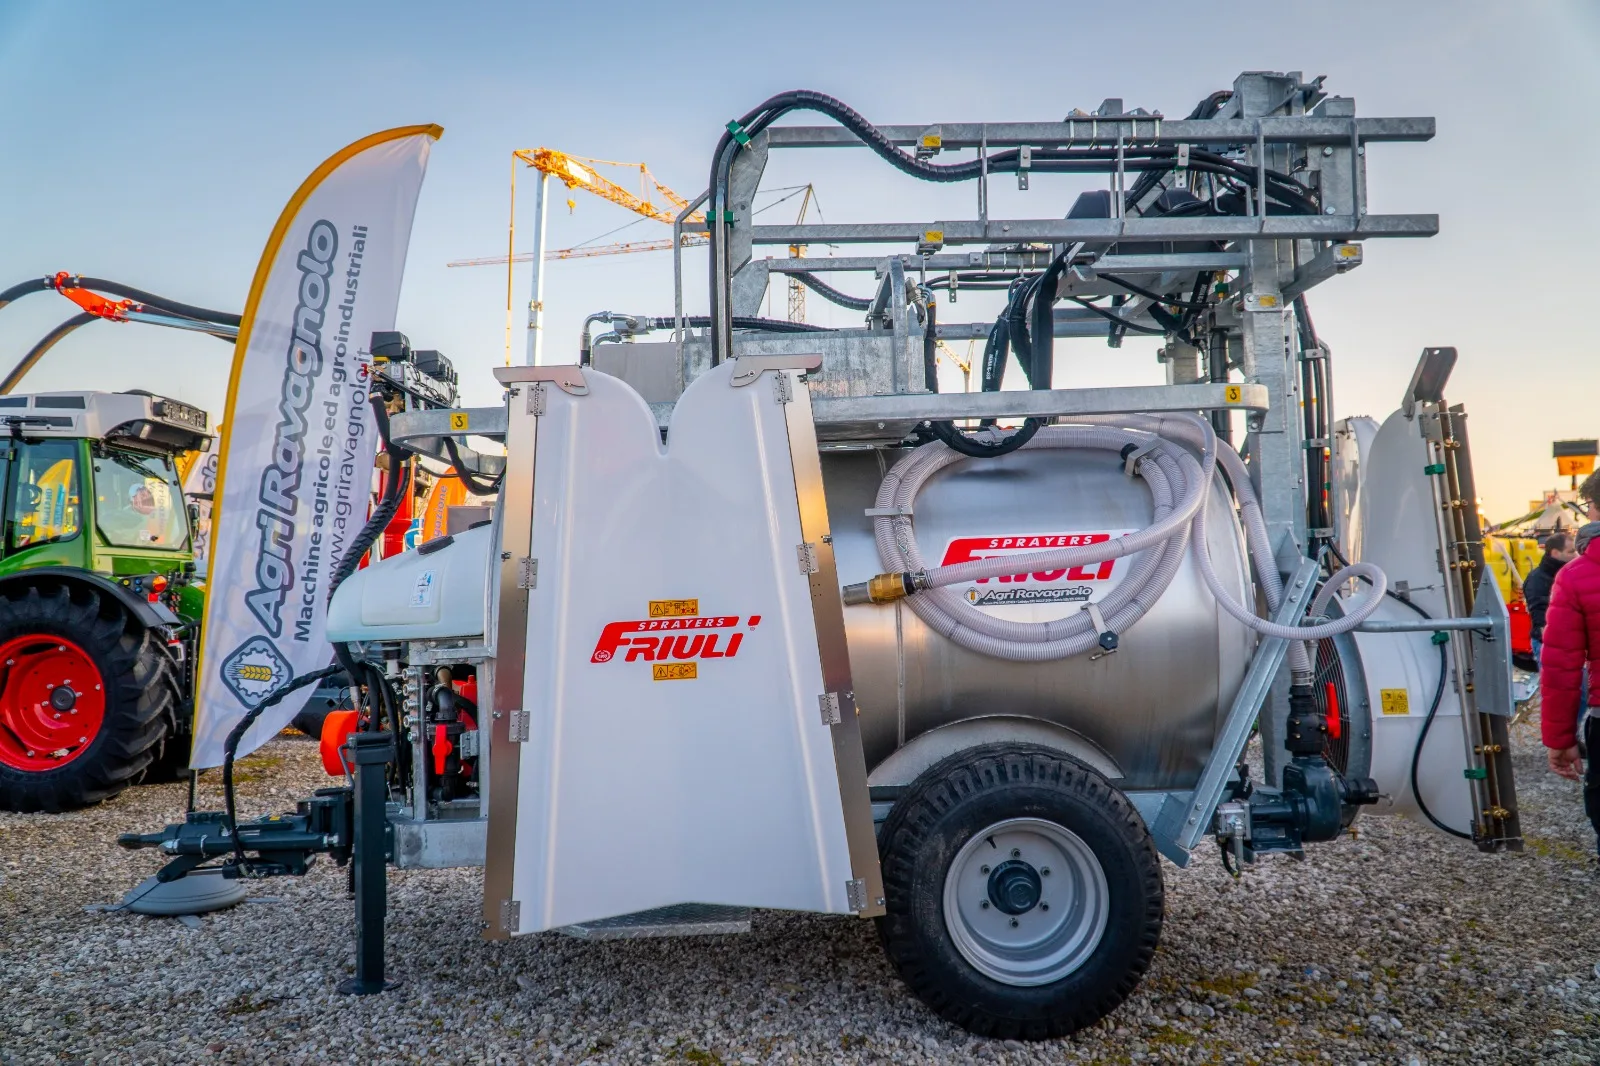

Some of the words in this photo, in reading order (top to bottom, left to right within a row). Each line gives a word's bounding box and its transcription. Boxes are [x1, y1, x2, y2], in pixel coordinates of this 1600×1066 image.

[330, 225, 368, 396] agroindustriali
[245, 219, 338, 638] AgriRavagnolo
[323, 402, 338, 430] ed
[313, 431, 333, 528] agricole
[989, 535, 1093, 548] SPRAYERS
[294, 532, 321, 642] Macchine
[591, 618, 744, 663] FRIULI
[637, 617, 725, 631] SPRAYERS
